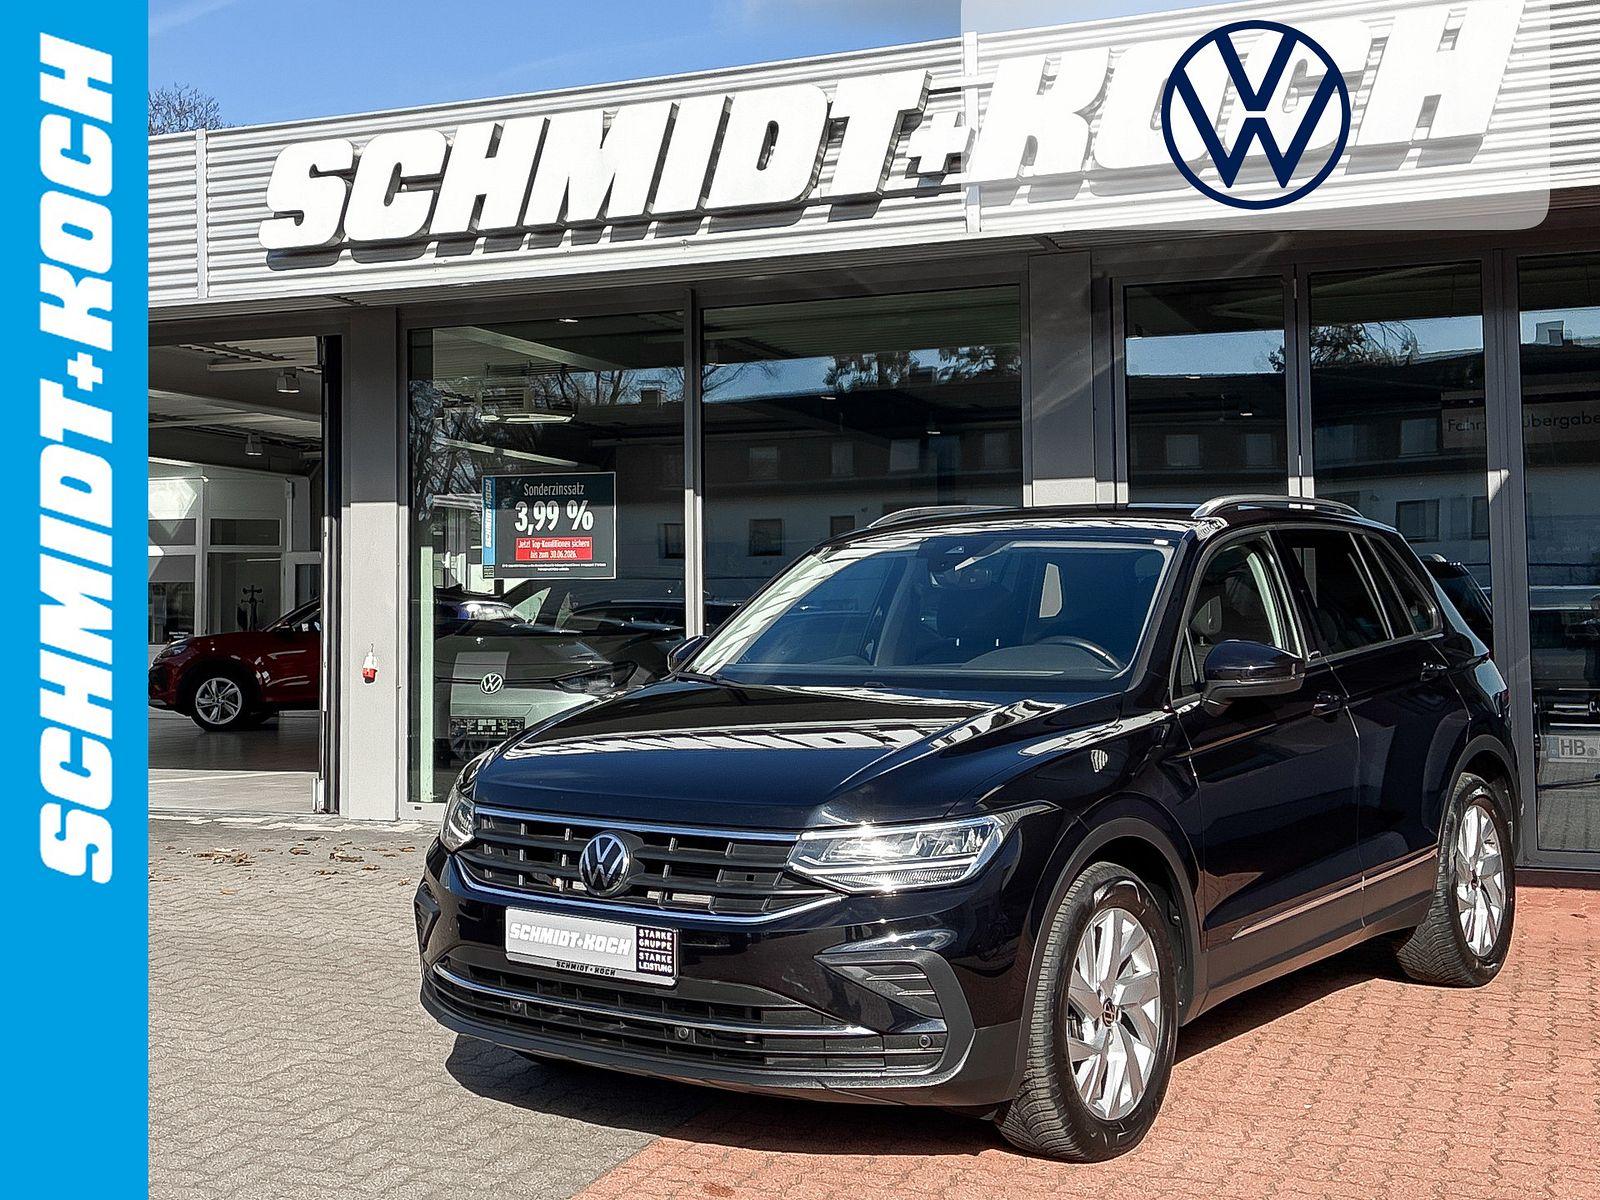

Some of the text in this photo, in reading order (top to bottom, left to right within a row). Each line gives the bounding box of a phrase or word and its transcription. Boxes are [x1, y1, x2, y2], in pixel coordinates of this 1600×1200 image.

[523, 482, 585, 496] Sonderzinssatz
[514, 499, 594, 535] 3,99 %
[572, 539, 590, 548] sichern
[638, 928, 673, 941] STARKE
[638, 939, 673, 951] GRUPPE
[638, 952, 673, 964] STARKE
[638, 961, 673, 973] LEISTUNG
